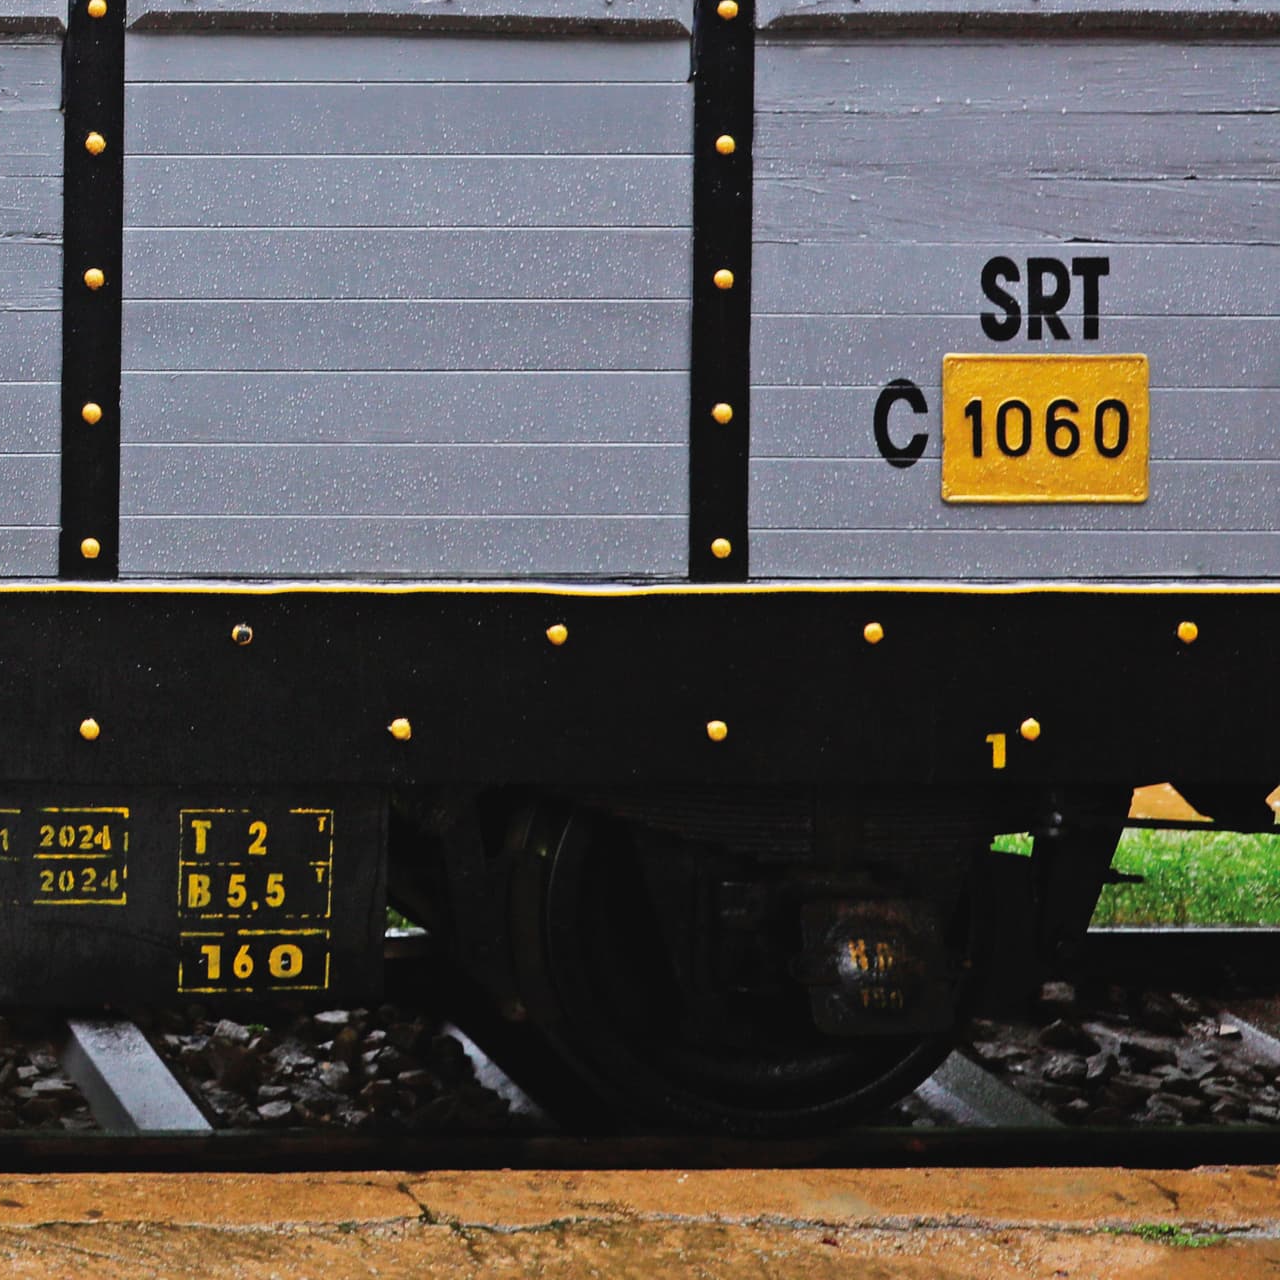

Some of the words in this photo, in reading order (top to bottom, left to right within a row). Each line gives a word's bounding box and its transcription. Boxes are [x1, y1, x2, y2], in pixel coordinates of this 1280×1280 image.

[980, 256, 1110, 342] SRT
[873, 378, 929, 469] C
[964, 398, 1130, 458] 1060
[985, 733, 1006, 769] 1
[40, 824, 112, 851] 2024
[191, 819, 212, 855] T
[247, 820, 268, 856] 2
[40, 867, 119, 892] 2024
[187, 873, 212, 909] B
[200, 944, 304, 980] 160
